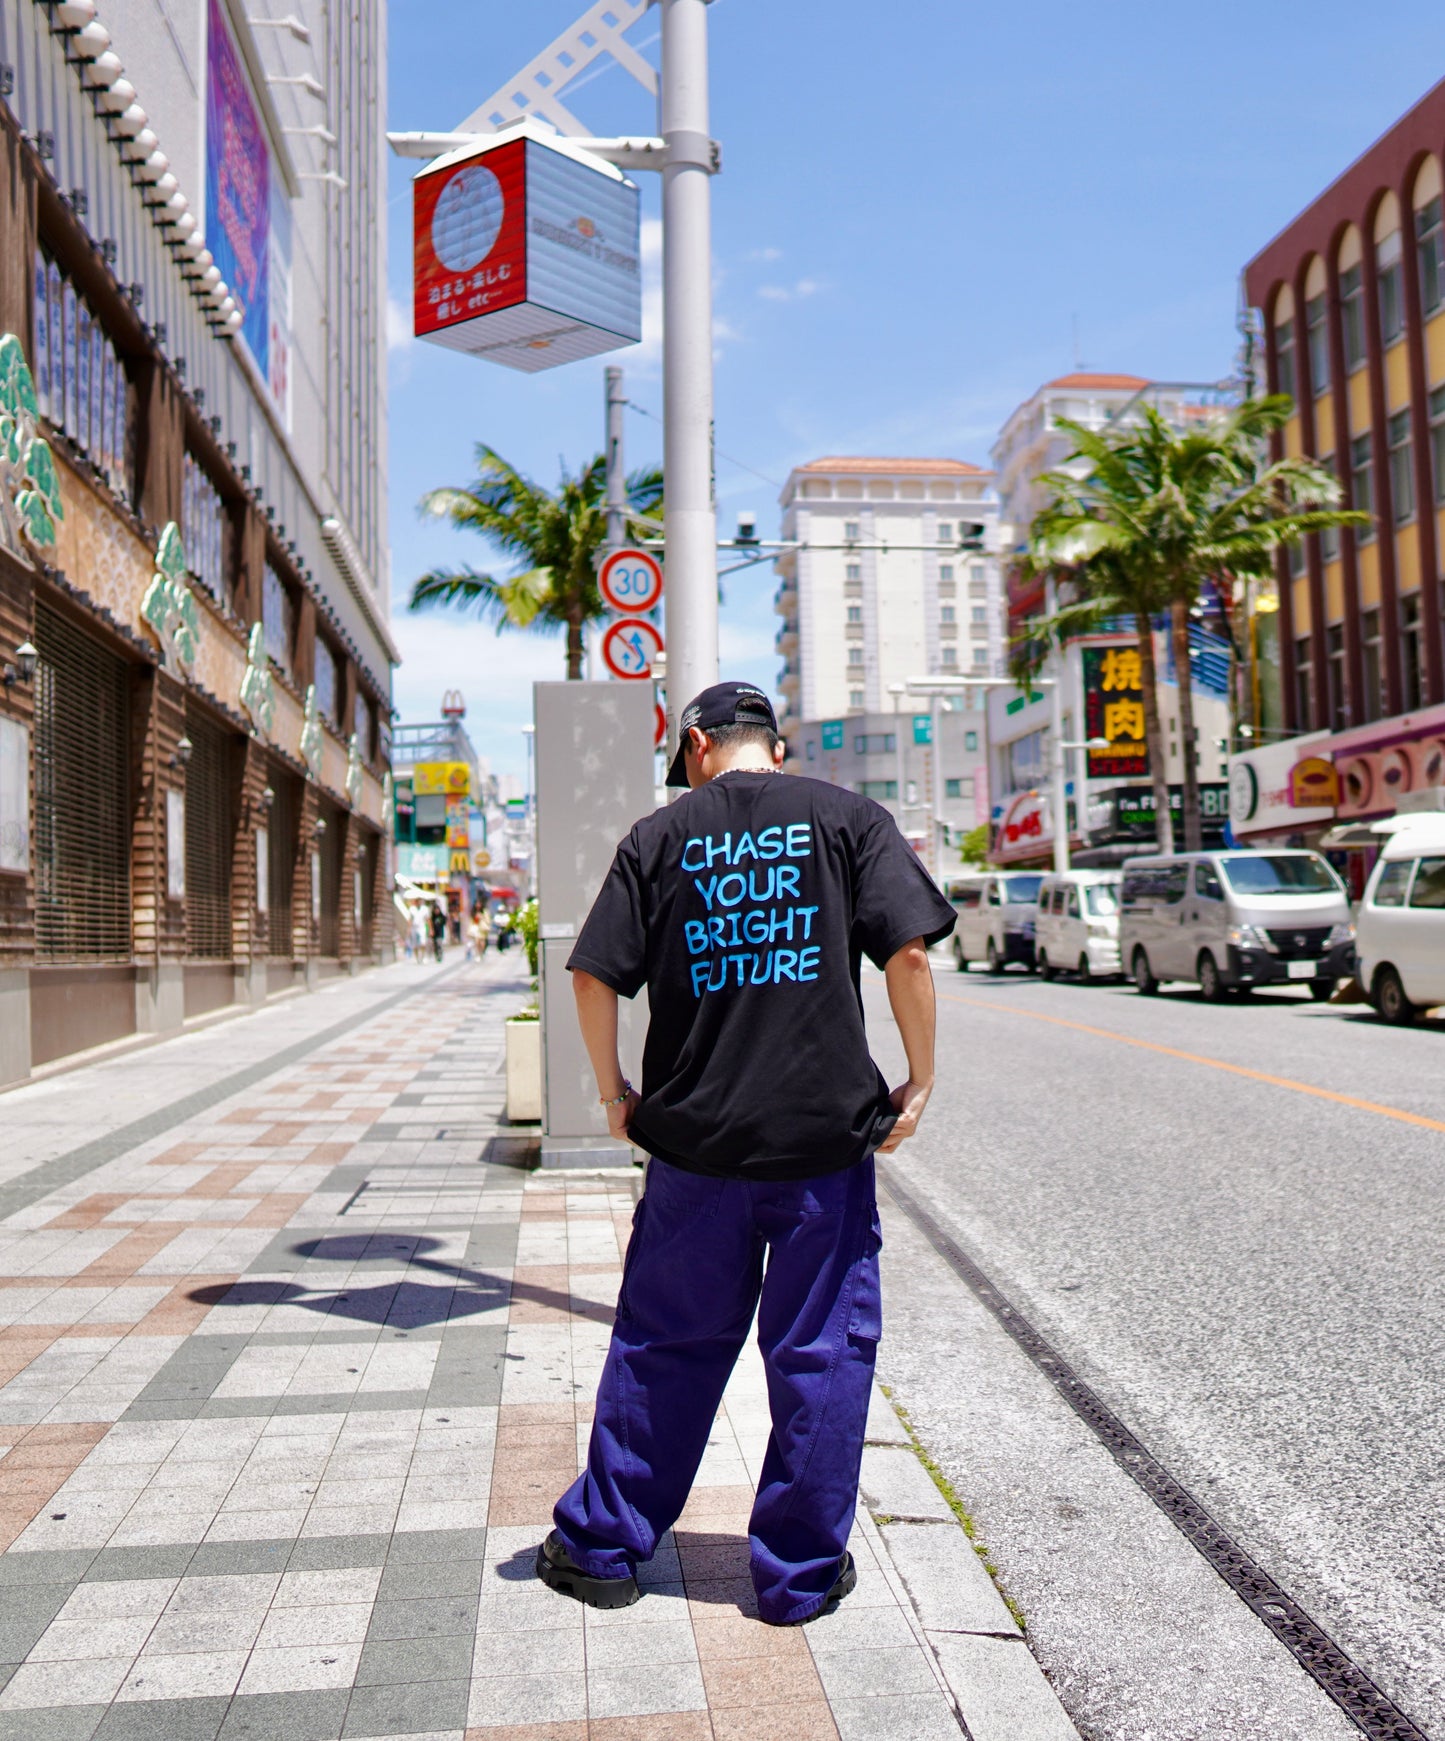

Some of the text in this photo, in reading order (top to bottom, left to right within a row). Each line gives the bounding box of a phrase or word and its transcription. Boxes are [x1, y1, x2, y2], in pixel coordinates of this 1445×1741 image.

[615, 568, 649, 596] 30
[1089, 759, 1146, 776] STEAK
[681, 823, 811, 871] CHASE
[694, 865, 800, 911] YOUR
[684, 905, 819, 955] BRIGHT
[690, 946, 821, 998] FUTURE
